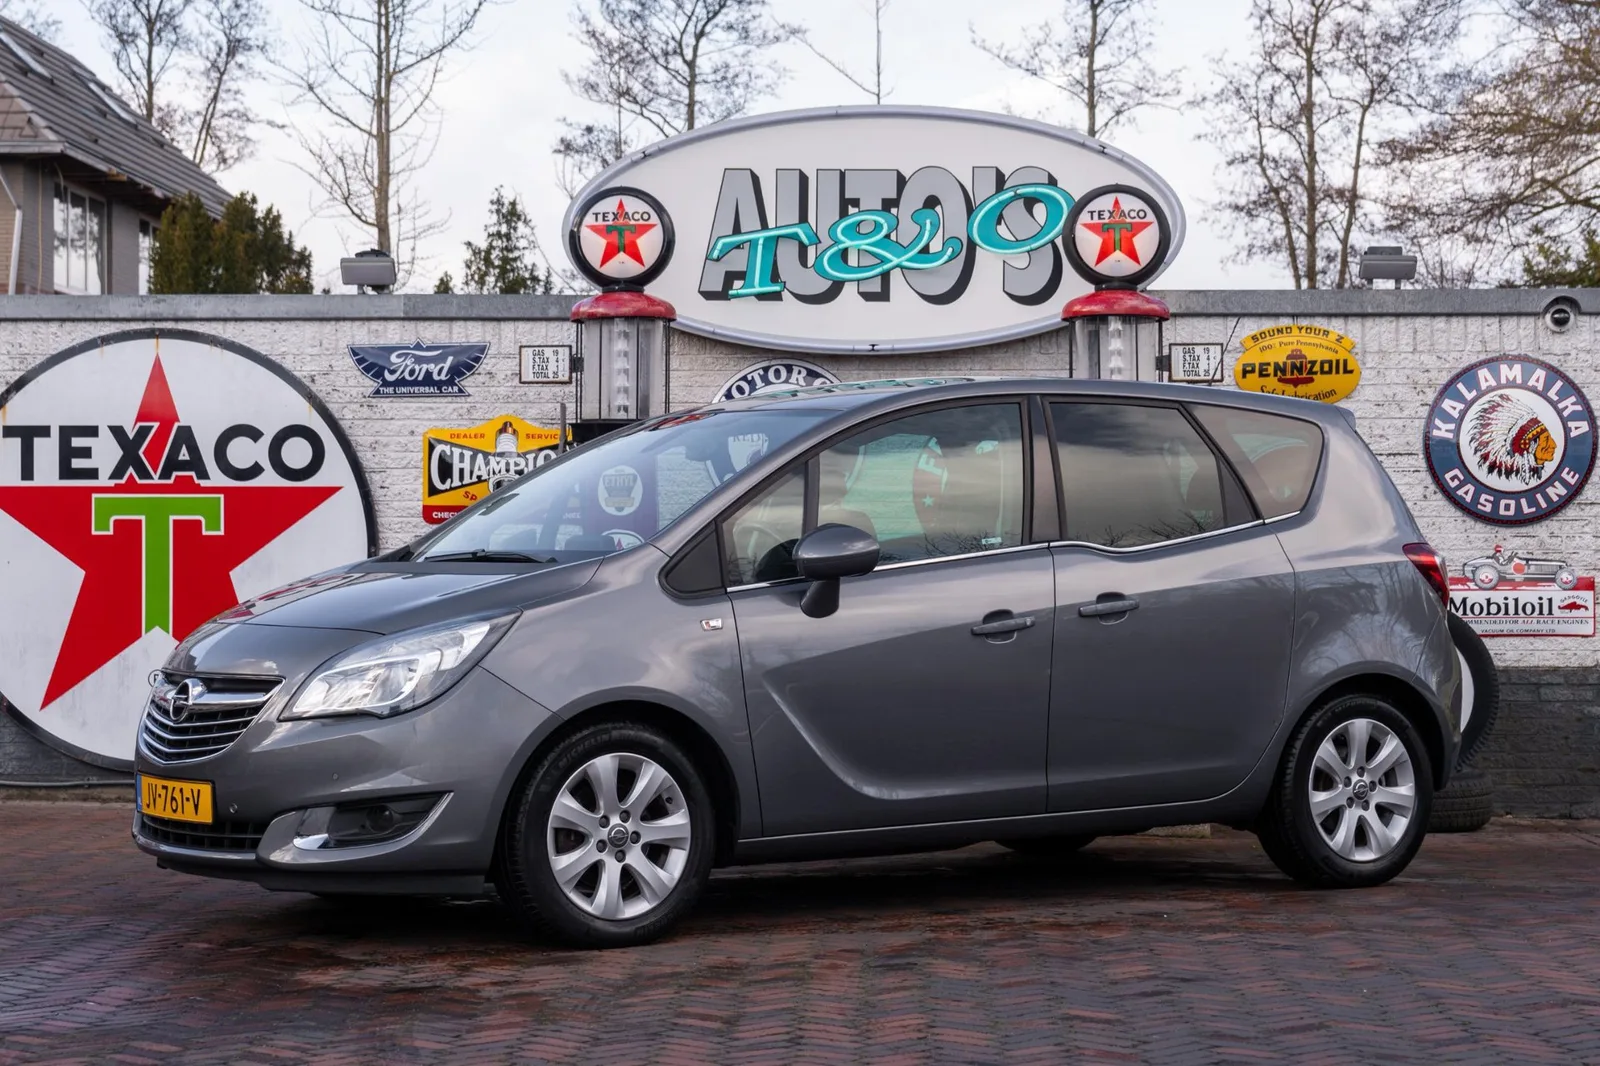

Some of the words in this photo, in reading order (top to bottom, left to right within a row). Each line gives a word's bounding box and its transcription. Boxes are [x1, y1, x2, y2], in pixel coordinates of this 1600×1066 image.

[592, 211, 651, 222] TEXACO
[1088, 209, 1147, 220] TEXACO
[698, 166, 1063, 306] AUTO'S
[1251, 326, 1292, 343] SOUND
[1297, 326, 1330, 338] YOUR
[1335, 334, 1345, 344] Z
[552, 349, 559, 357] 19
[1296, 340, 1339, 355] Pennsylvania
[384, 350, 454, 381] Ford
[552, 371, 560, 379] 25
[1203, 369, 1211, 377] 25
[1242, 359, 1354, 379] PENNZOIL
[395, 386, 439, 394] UNIVERSAL
[720, 365, 807, 401] OTOR
[1432, 364, 1589, 439] KALAMALKA
[2, 424, 326, 482] TEXACO
[430, 444, 578, 491] CHAMPIO
[462, 490, 478, 501] SP
[1444, 467, 1580, 517] GASOLINE
[92, 494, 224, 635] T
[1449, 596, 1554, 617] Mobiloil
[146, 782, 201, 816] JV-761-V
